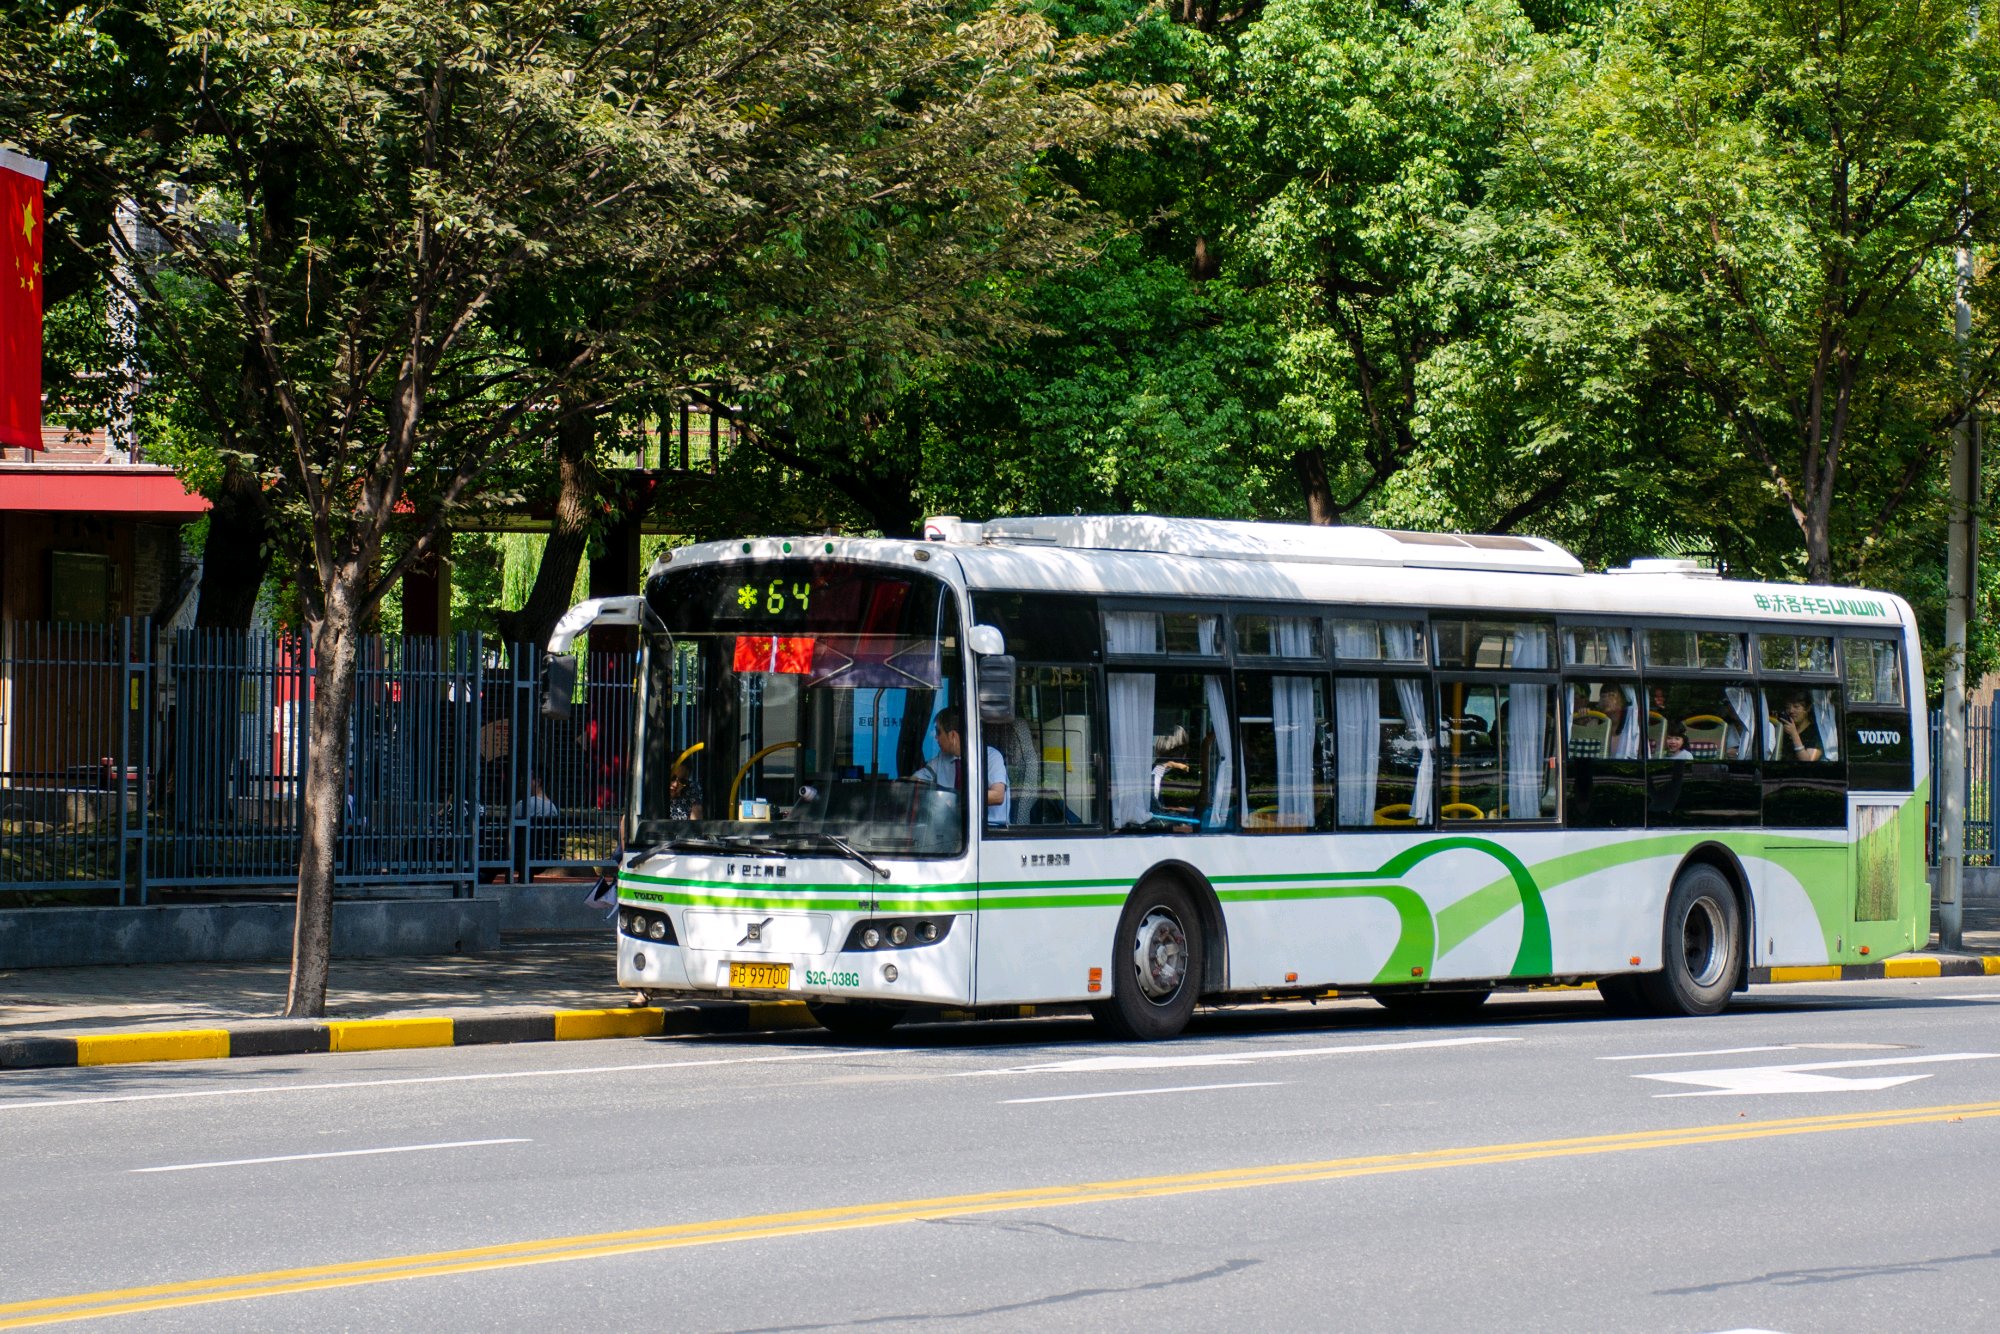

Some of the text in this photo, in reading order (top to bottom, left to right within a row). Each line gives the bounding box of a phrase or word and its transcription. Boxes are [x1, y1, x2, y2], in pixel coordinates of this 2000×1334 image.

[767, 579, 810, 614] 64
[1753, 592, 1886, 617] 申沃客车 SUNWIN
[1857, 730, 1901, 744] VOLVO
[806, 970, 859, 987] S2G-038G
